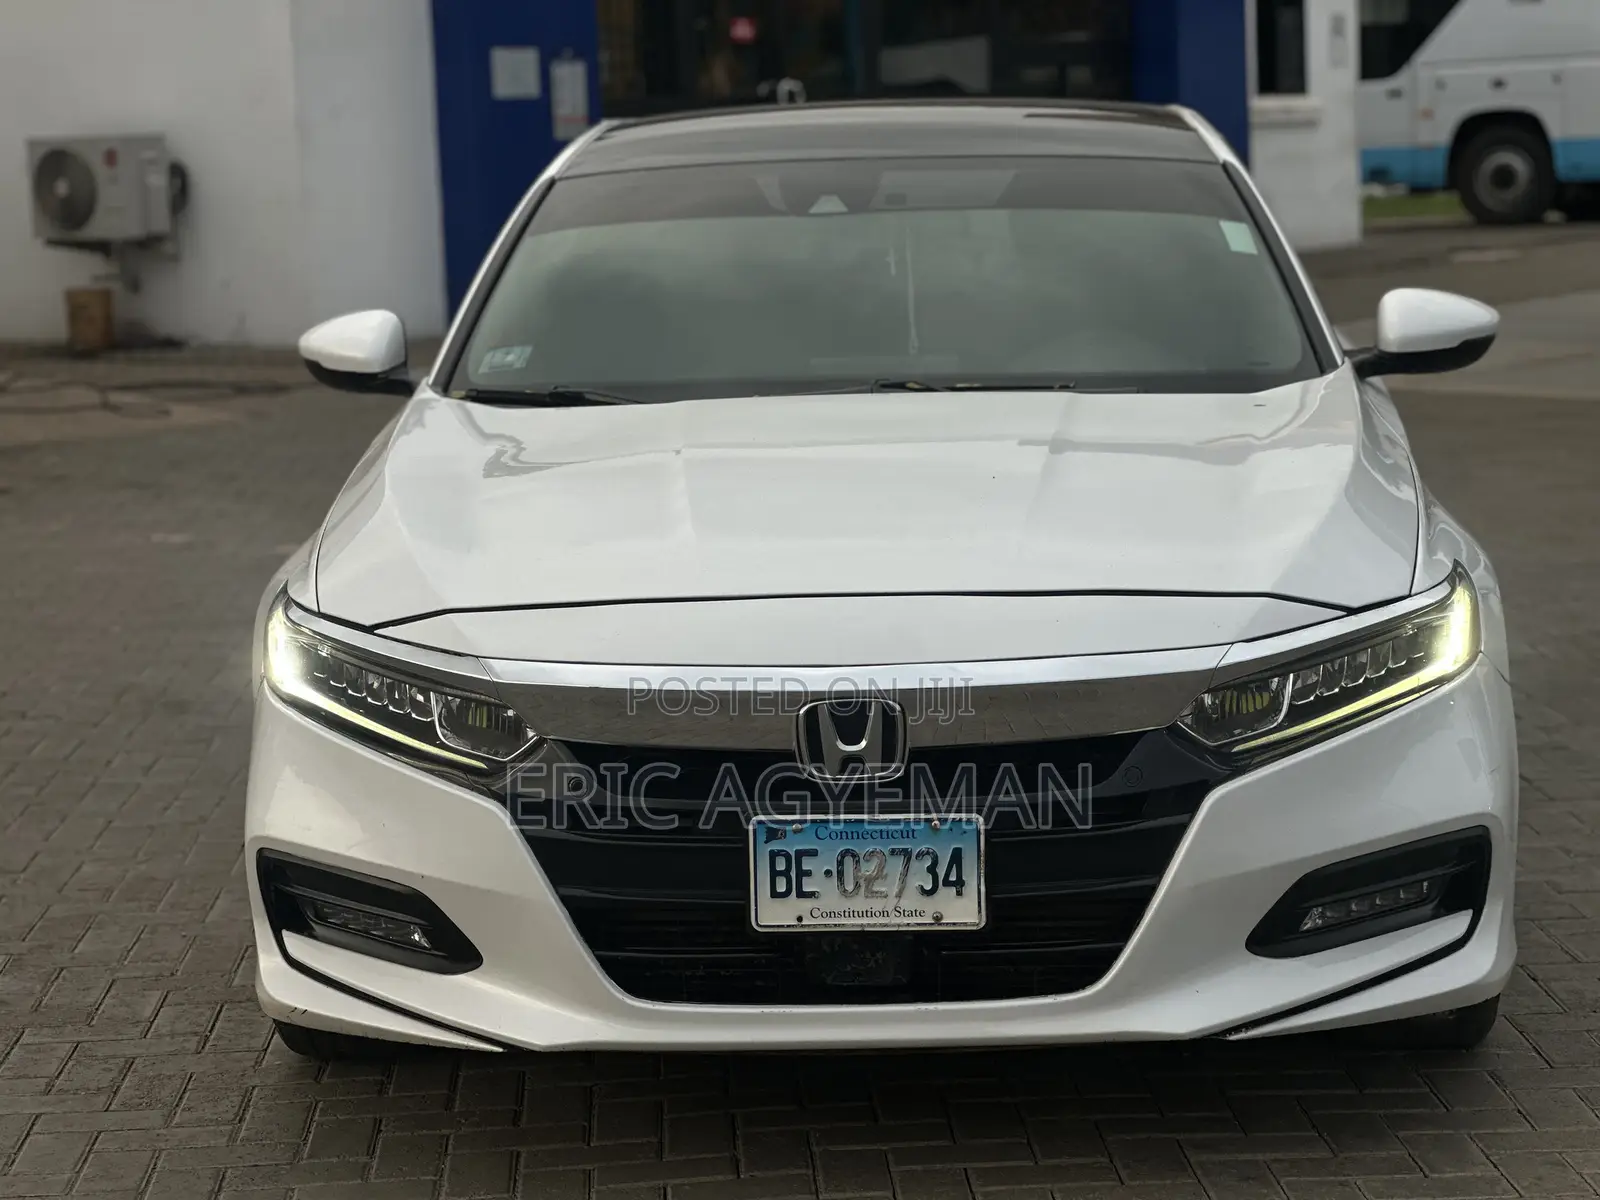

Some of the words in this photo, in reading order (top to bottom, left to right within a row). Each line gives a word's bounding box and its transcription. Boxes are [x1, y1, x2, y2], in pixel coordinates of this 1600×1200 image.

[815, 825, 917, 841] Connecticut
[810, 906, 889, 919] Constitution
[894, 907, 926, 919] State
